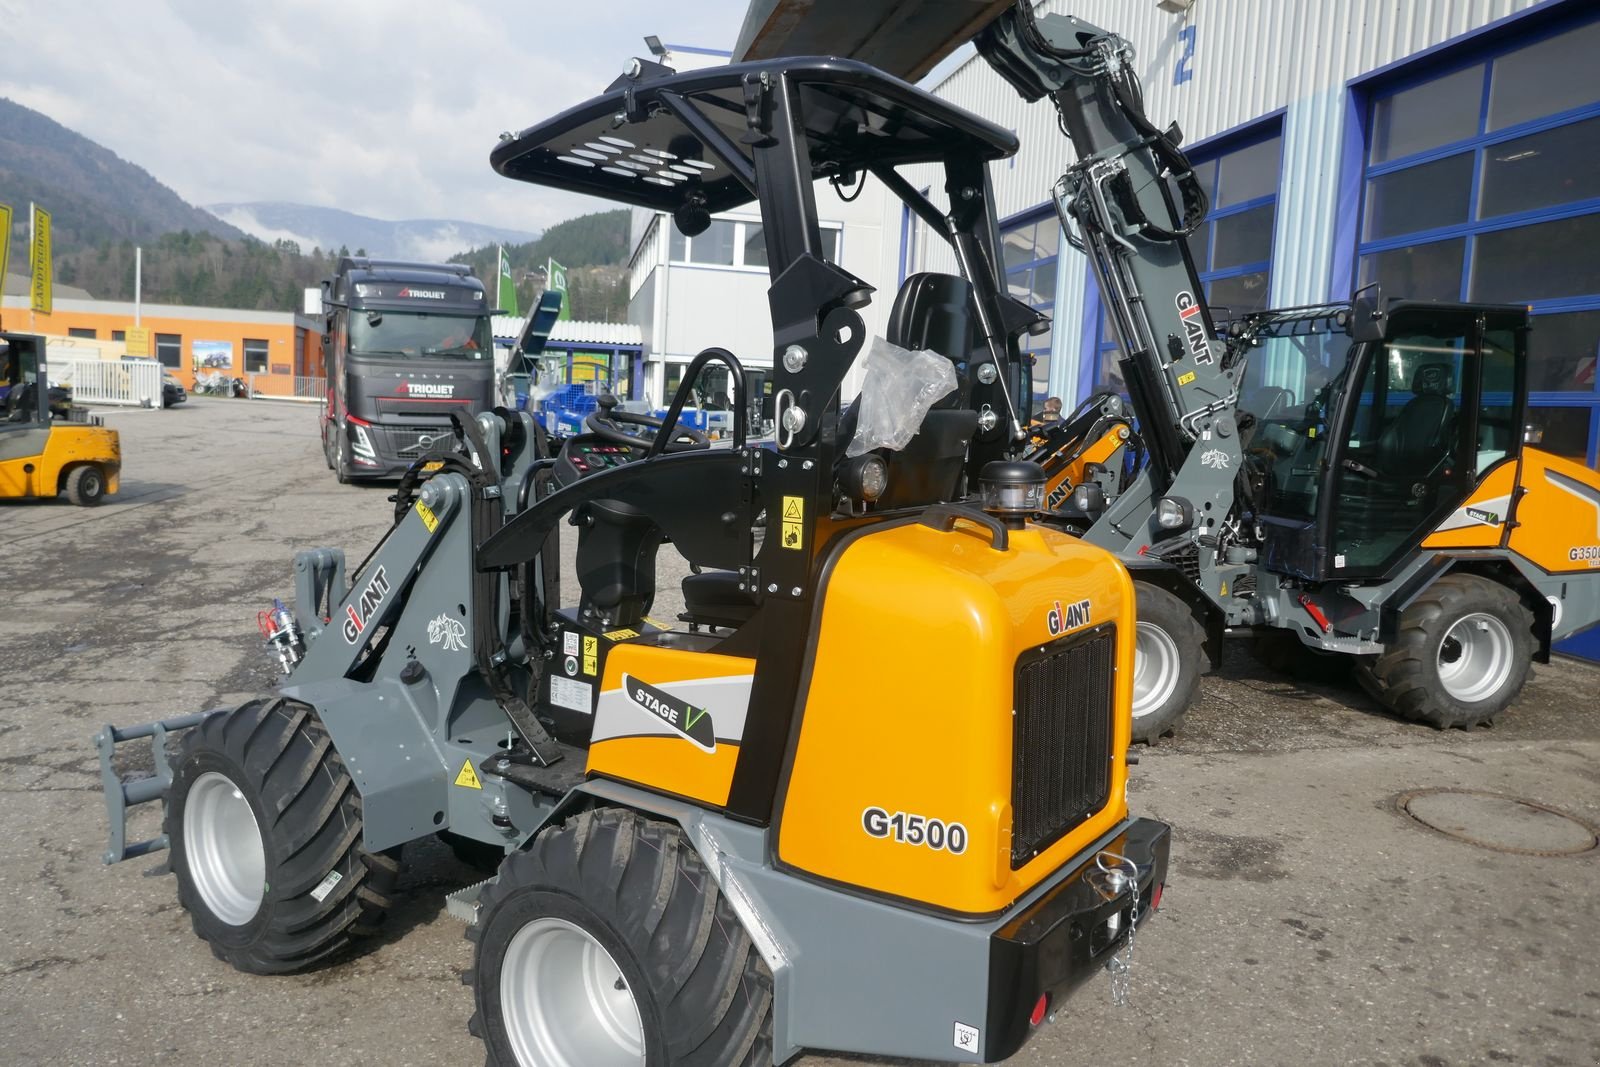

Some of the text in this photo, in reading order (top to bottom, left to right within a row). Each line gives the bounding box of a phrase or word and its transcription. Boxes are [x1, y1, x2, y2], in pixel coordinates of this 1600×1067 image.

[1173, 25, 1196, 86] 2
[1470, 510, 1487, 521] STAGE
[635, 688, 707, 732] STAGE V
[862, 807, 967, 854] G1500
